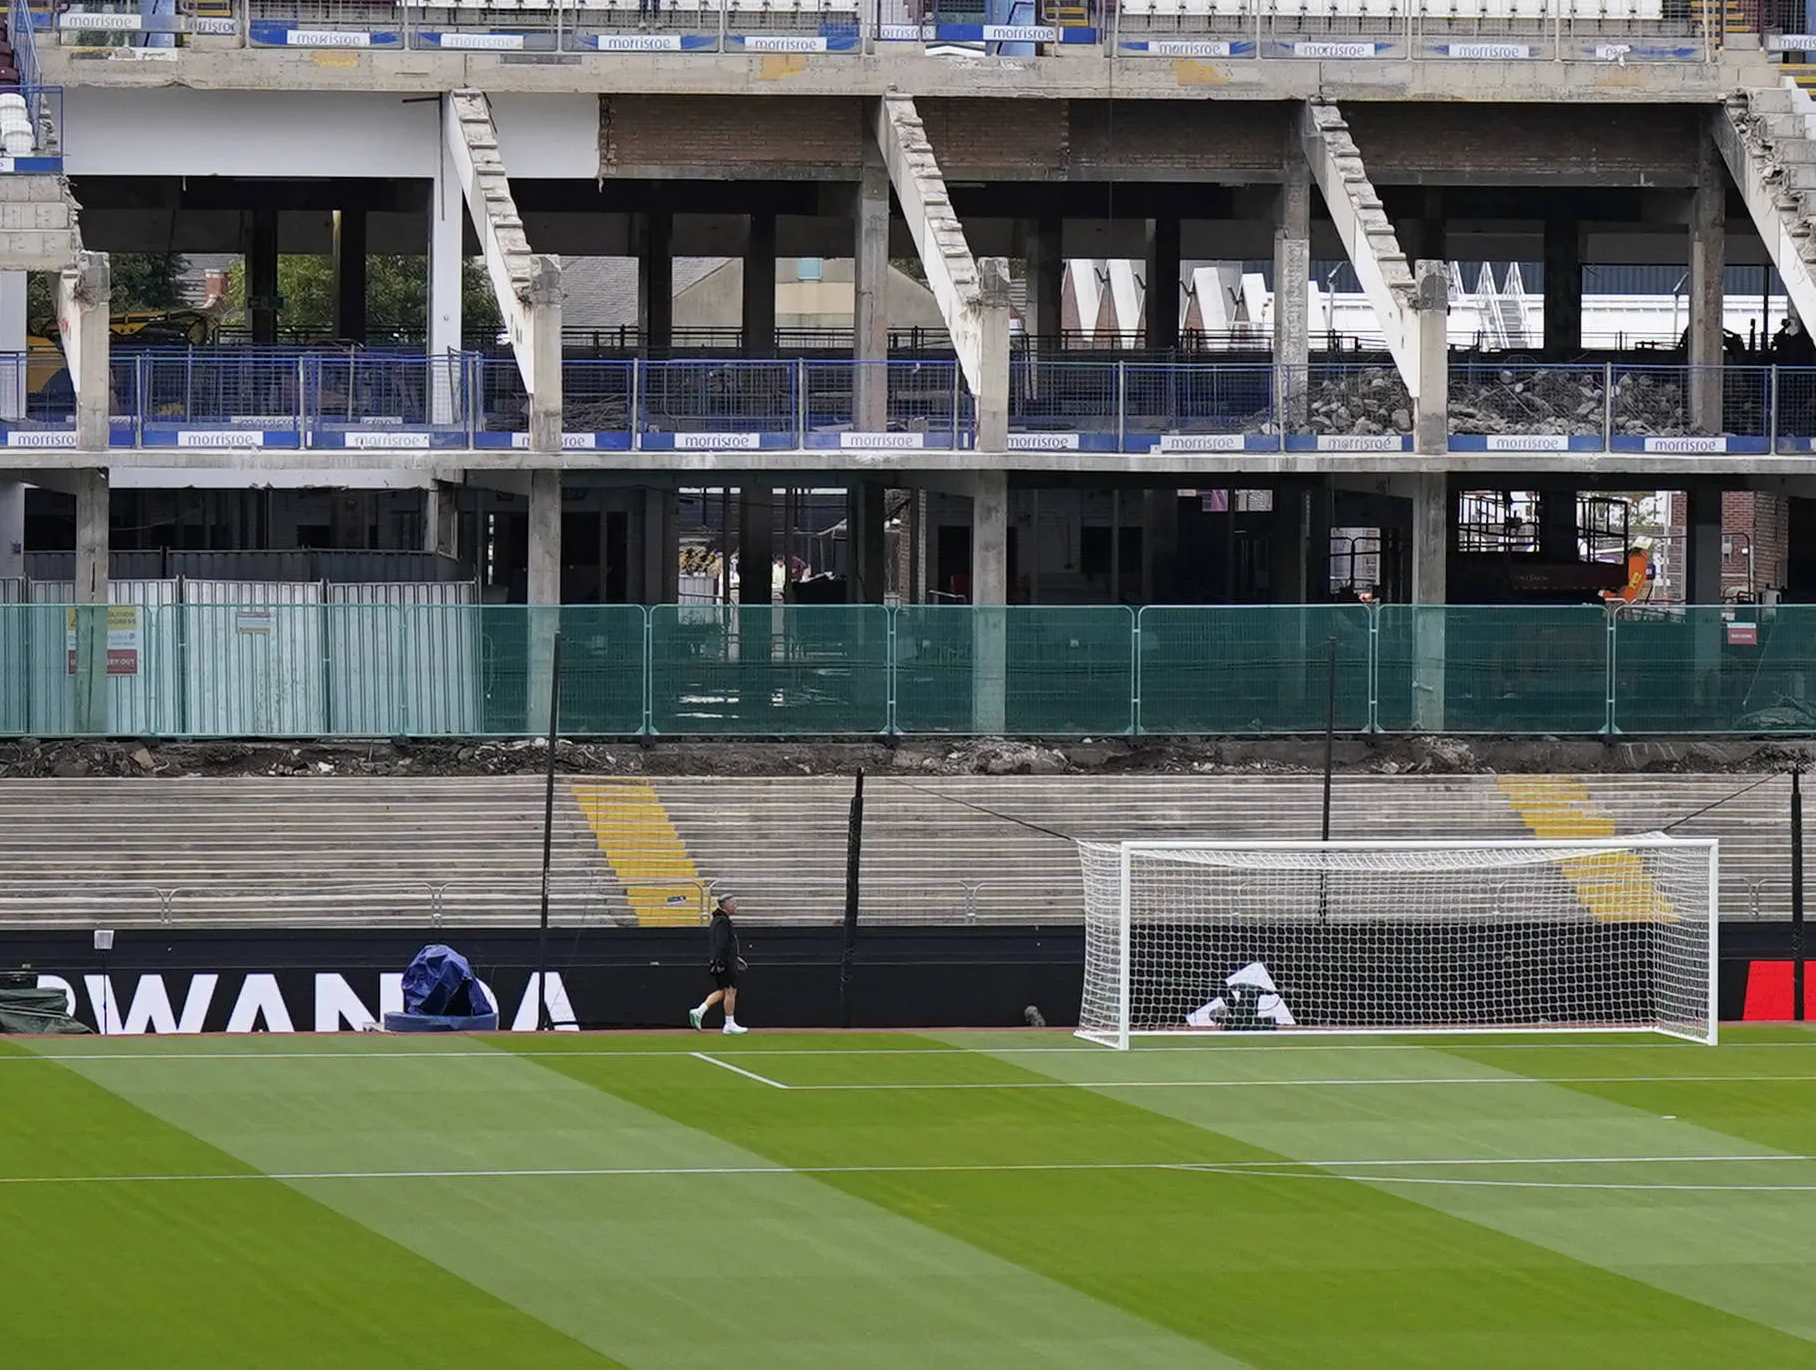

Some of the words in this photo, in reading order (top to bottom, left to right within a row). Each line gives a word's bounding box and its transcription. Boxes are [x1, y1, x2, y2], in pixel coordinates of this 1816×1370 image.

[68, 14, 131, 28] morrisroe
[297, 30, 361, 44] morrisroe
[993, 27, 1053, 40] morrisroe
[608, 36, 671, 50] morrisroe
[755, 37, 817, 50] morrisroe
[1159, 41, 1220, 55] morrisroe
[1303, 42, 1365, 57] morrisroe
[1459, 44, 1520, 58] morrisroe
[188, 432, 254, 446] morrisroe
[354, 433, 420, 447] morrisroe
[685, 433, 749, 447] morrisroe
[850, 433, 914, 447] morrisroe
[1170, 436, 1234, 450] morrisroe
[1328, 437, 1391, 451] morrisroe
[1496, 436, 1560, 450] morrisroe
[1654, 438, 1716, 452] morrisroe
